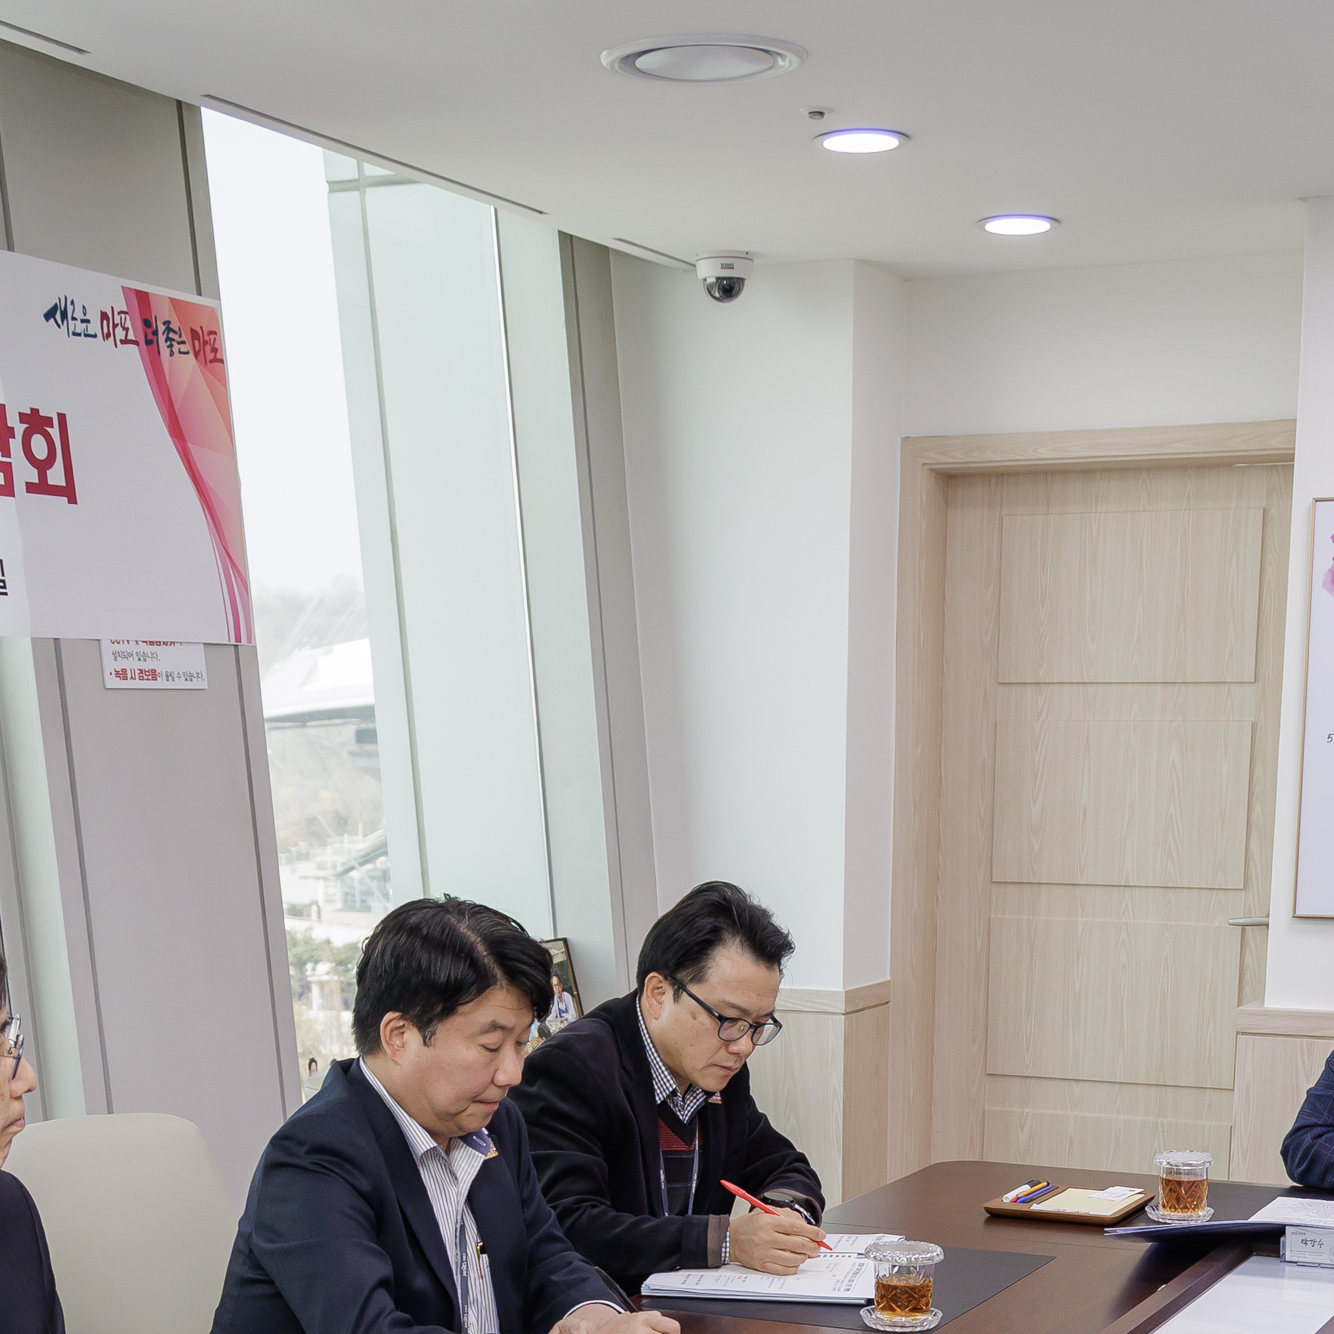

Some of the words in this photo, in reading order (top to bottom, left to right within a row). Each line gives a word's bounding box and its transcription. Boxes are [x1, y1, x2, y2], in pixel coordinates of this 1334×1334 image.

[43, 295, 97, 338] 새로운
[100, 306, 140, 348] 마포
[142, 315, 161, 356] 더
[162, 320, 190, 357] 좋은
[189, 325, 224, 366] 마포
